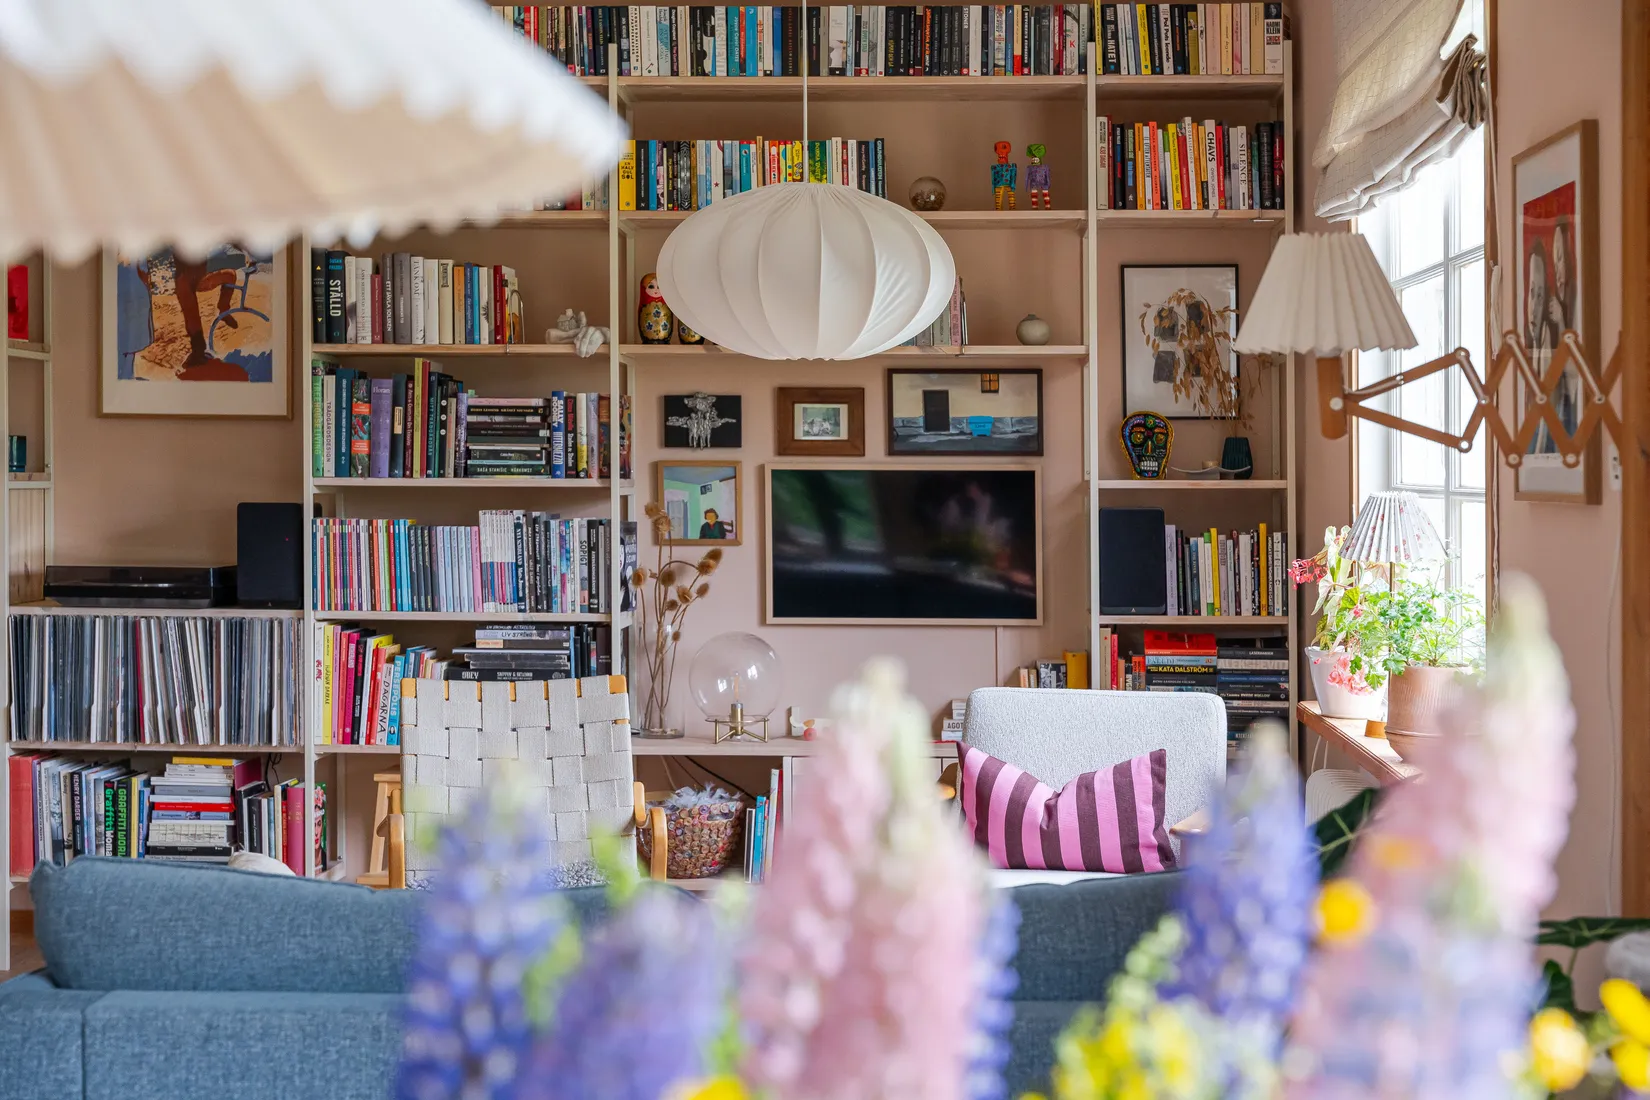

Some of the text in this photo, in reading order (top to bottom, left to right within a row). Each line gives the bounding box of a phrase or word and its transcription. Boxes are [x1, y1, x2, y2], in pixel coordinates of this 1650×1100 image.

[1107, 40, 1117, 64] HATET
[1207, 132, 1216, 162] CHAVS
[1239, 144, 1247, 185] SILENCE
[329, 279, 344, 317] STÄLLD
[580, 540, 588, 567] SOPIGT
[1175, 664, 1208, 673] DALSTRÖM
[391, 660, 402, 717] PERSEPOLIS
[378, 681, 391, 733] DAGARNA
[74, 796, 82, 821] DARGER
[117, 788, 127, 857] GRAFFITI WORL
